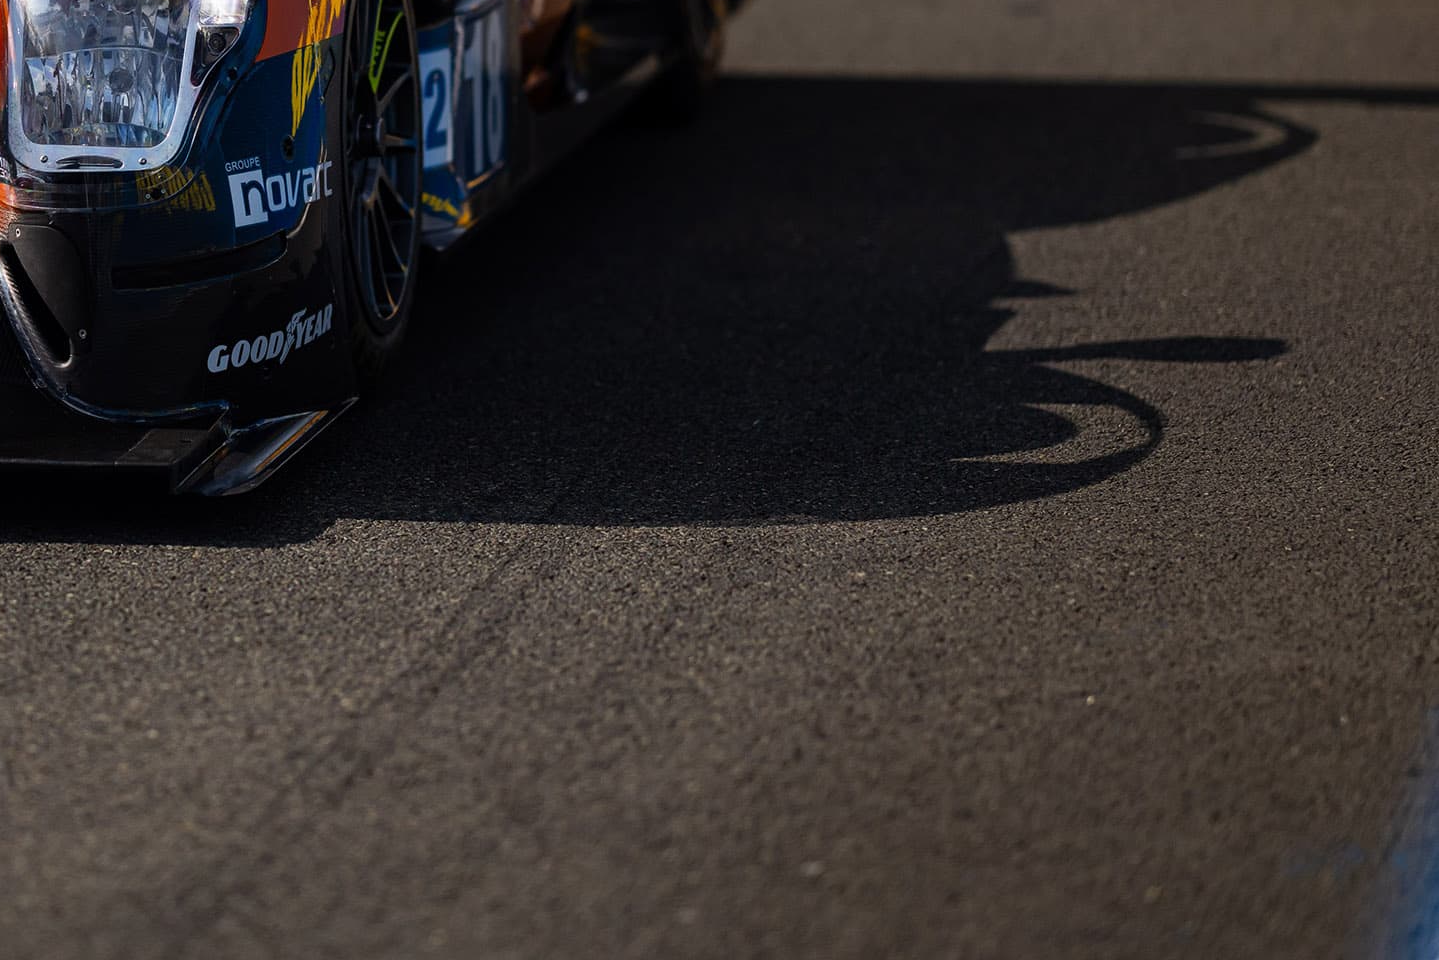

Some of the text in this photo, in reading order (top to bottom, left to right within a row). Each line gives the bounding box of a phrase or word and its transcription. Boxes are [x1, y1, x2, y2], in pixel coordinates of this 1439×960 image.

[464, 10, 505, 176] 18
[224, 156, 261, 173] GROUPE
[207, 303, 334, 374] GOODYEAR
